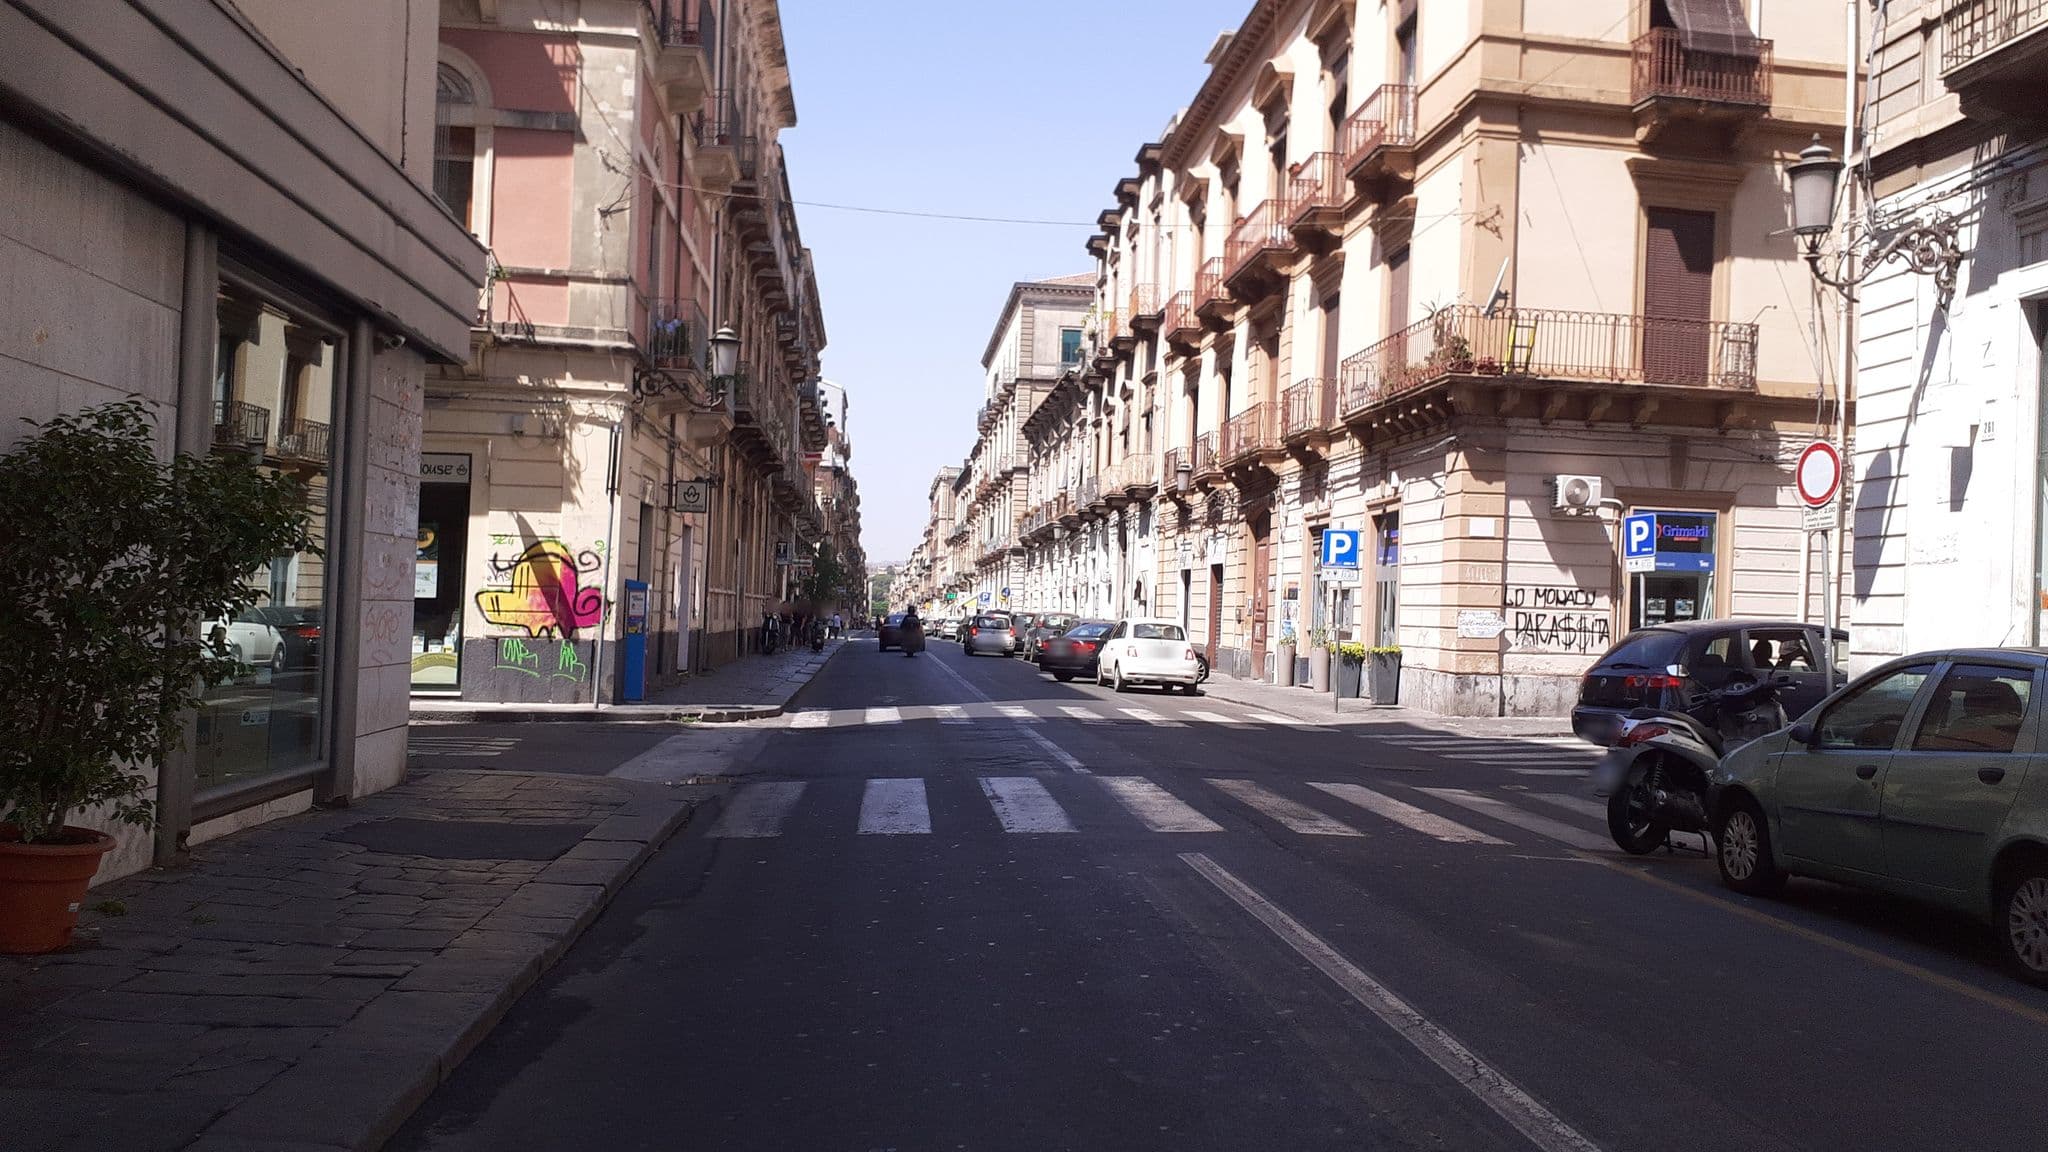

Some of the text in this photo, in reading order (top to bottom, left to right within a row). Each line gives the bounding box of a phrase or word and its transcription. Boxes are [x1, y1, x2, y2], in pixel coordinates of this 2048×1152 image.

[420, 462, 453, 475] ouse
[1630, 520, 1649, 552] P
[1662, 524, 1709, 538] Grimaldi
[1329, 532, 1352, 565] P
